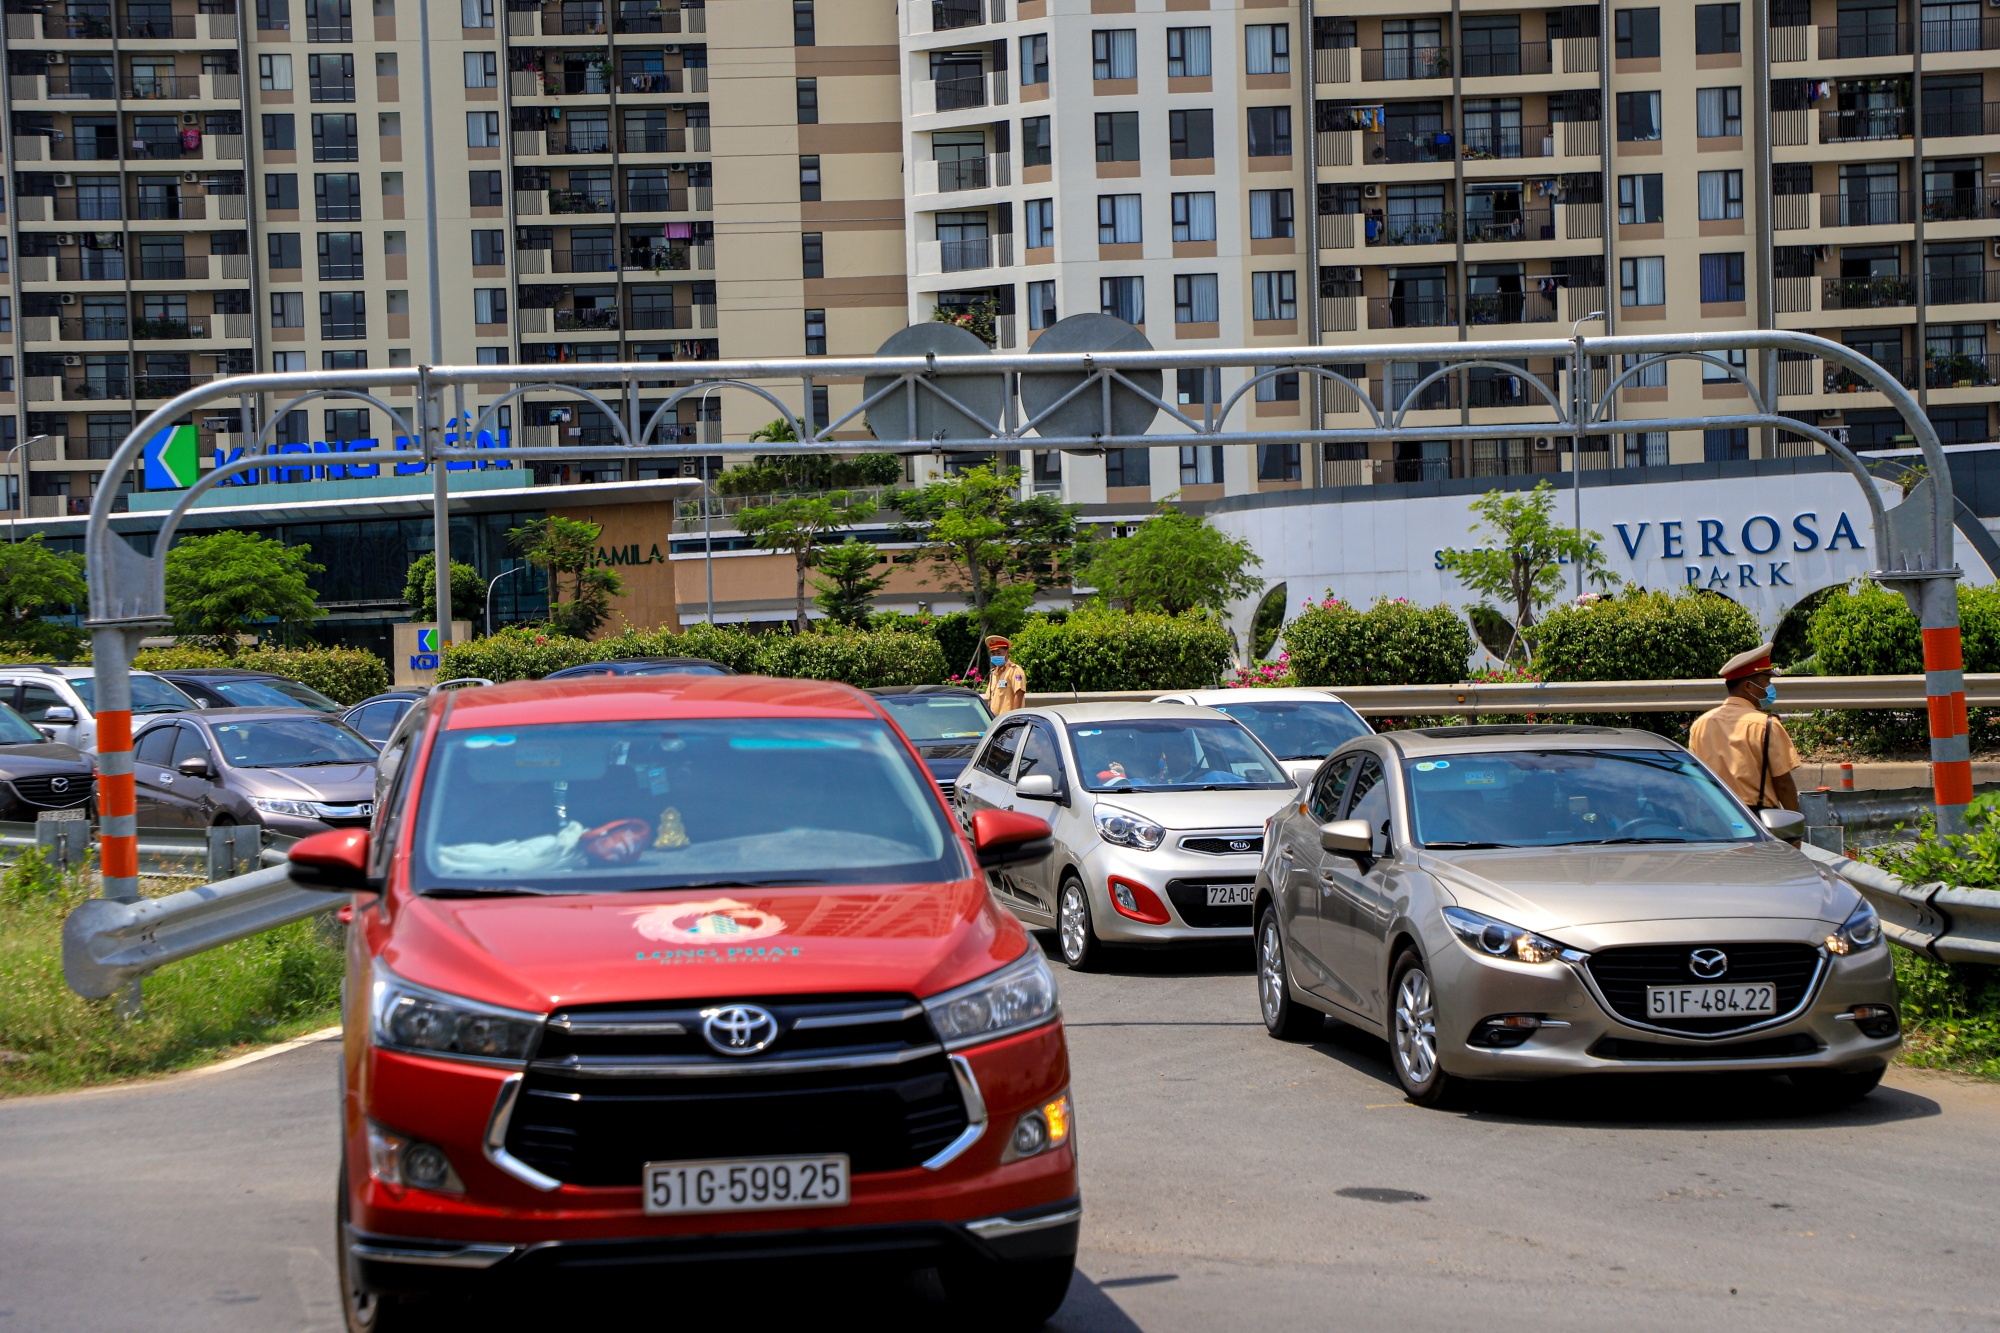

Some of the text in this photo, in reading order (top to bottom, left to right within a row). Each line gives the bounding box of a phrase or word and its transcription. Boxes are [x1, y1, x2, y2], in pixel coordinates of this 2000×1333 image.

[1612, 511, 1865, 560] VEROSA
[1685, 561, 1793, 589] PARK
[636, 949, 717, 961] LONG
[1653, 987, 1771, 1014] 51F-484.22
[652, 1162, 840, 1207] 51G-599.25
